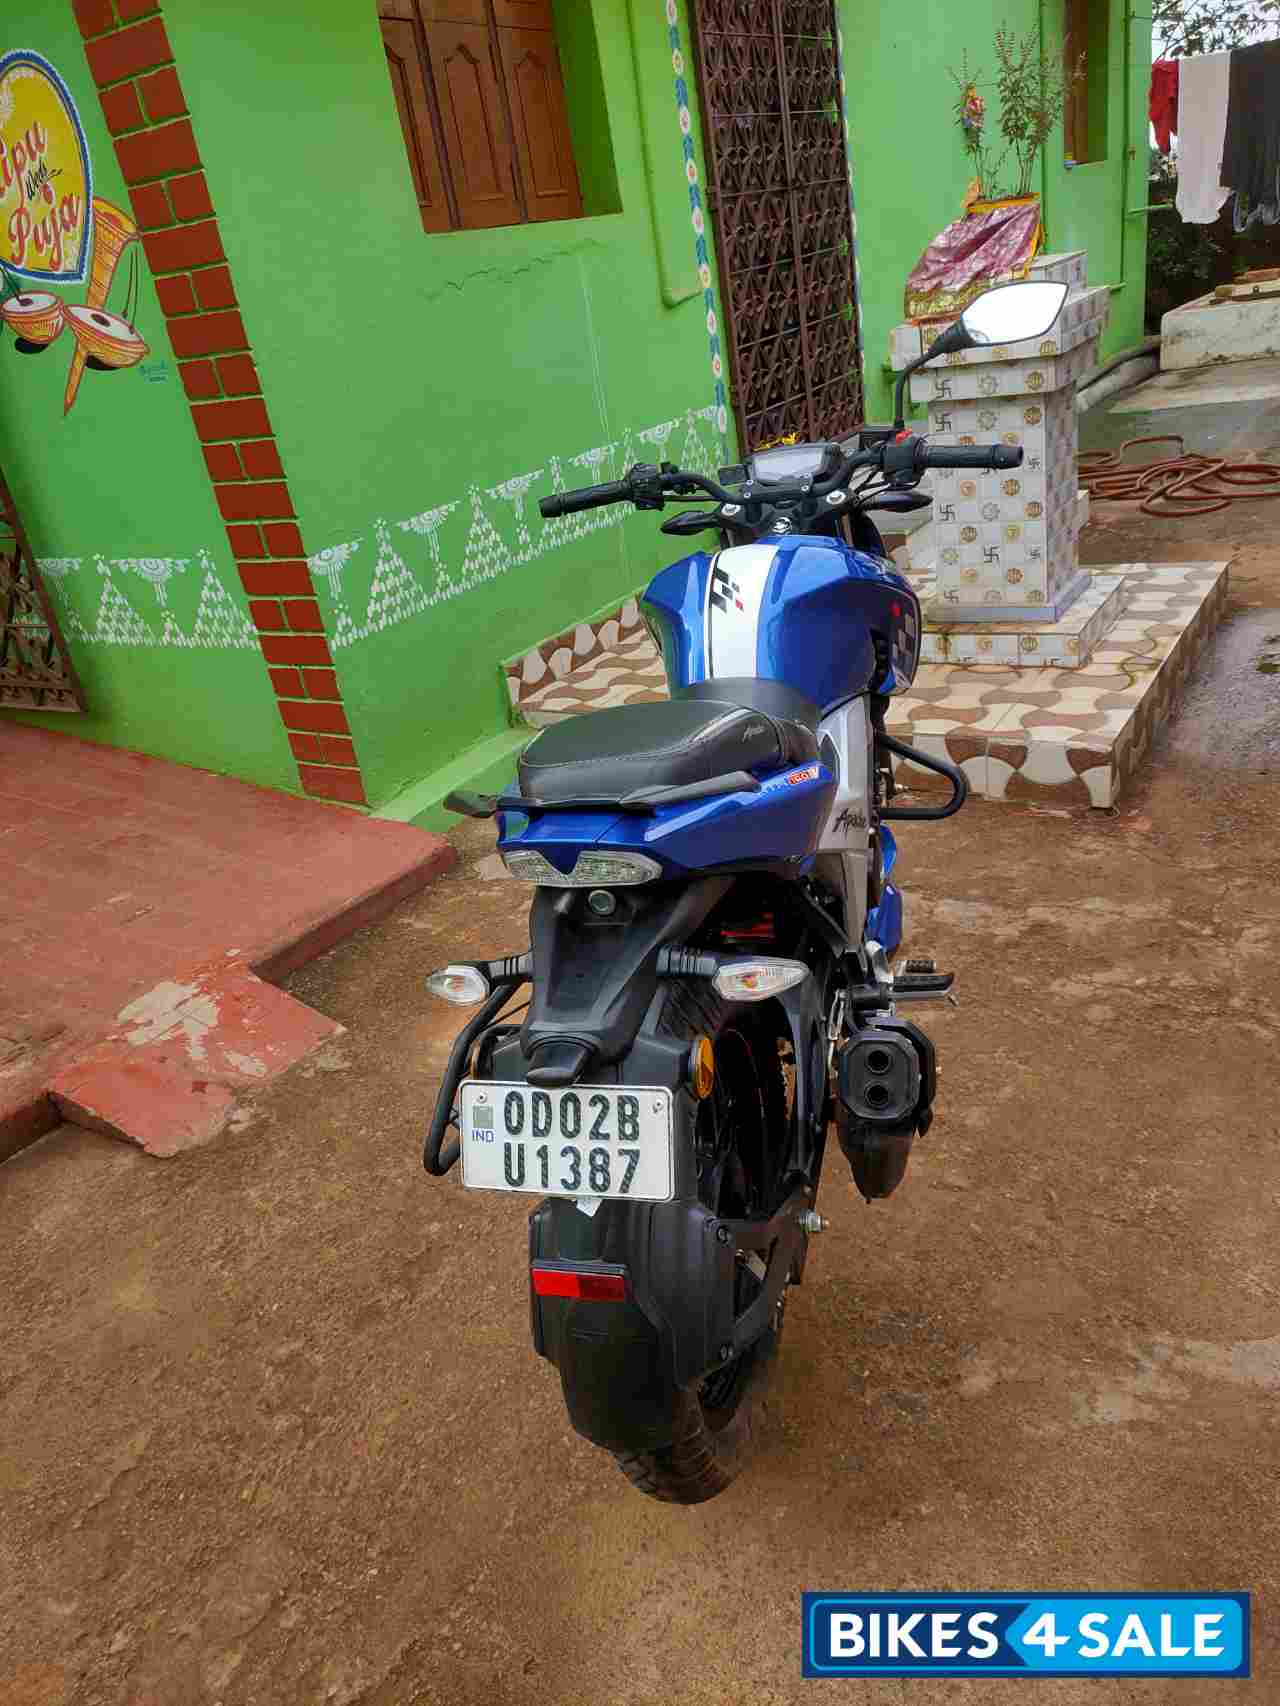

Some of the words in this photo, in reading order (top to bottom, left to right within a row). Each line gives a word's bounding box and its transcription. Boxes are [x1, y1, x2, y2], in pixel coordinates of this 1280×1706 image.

[0, 121, 47, 208] ipu
[8, 184, 80, 271] Puja
[472, 1129, 495, 1143] IND
[504, 1090, 640, 1142] OD02B
[504, 1142, 640, 1194] U1387
